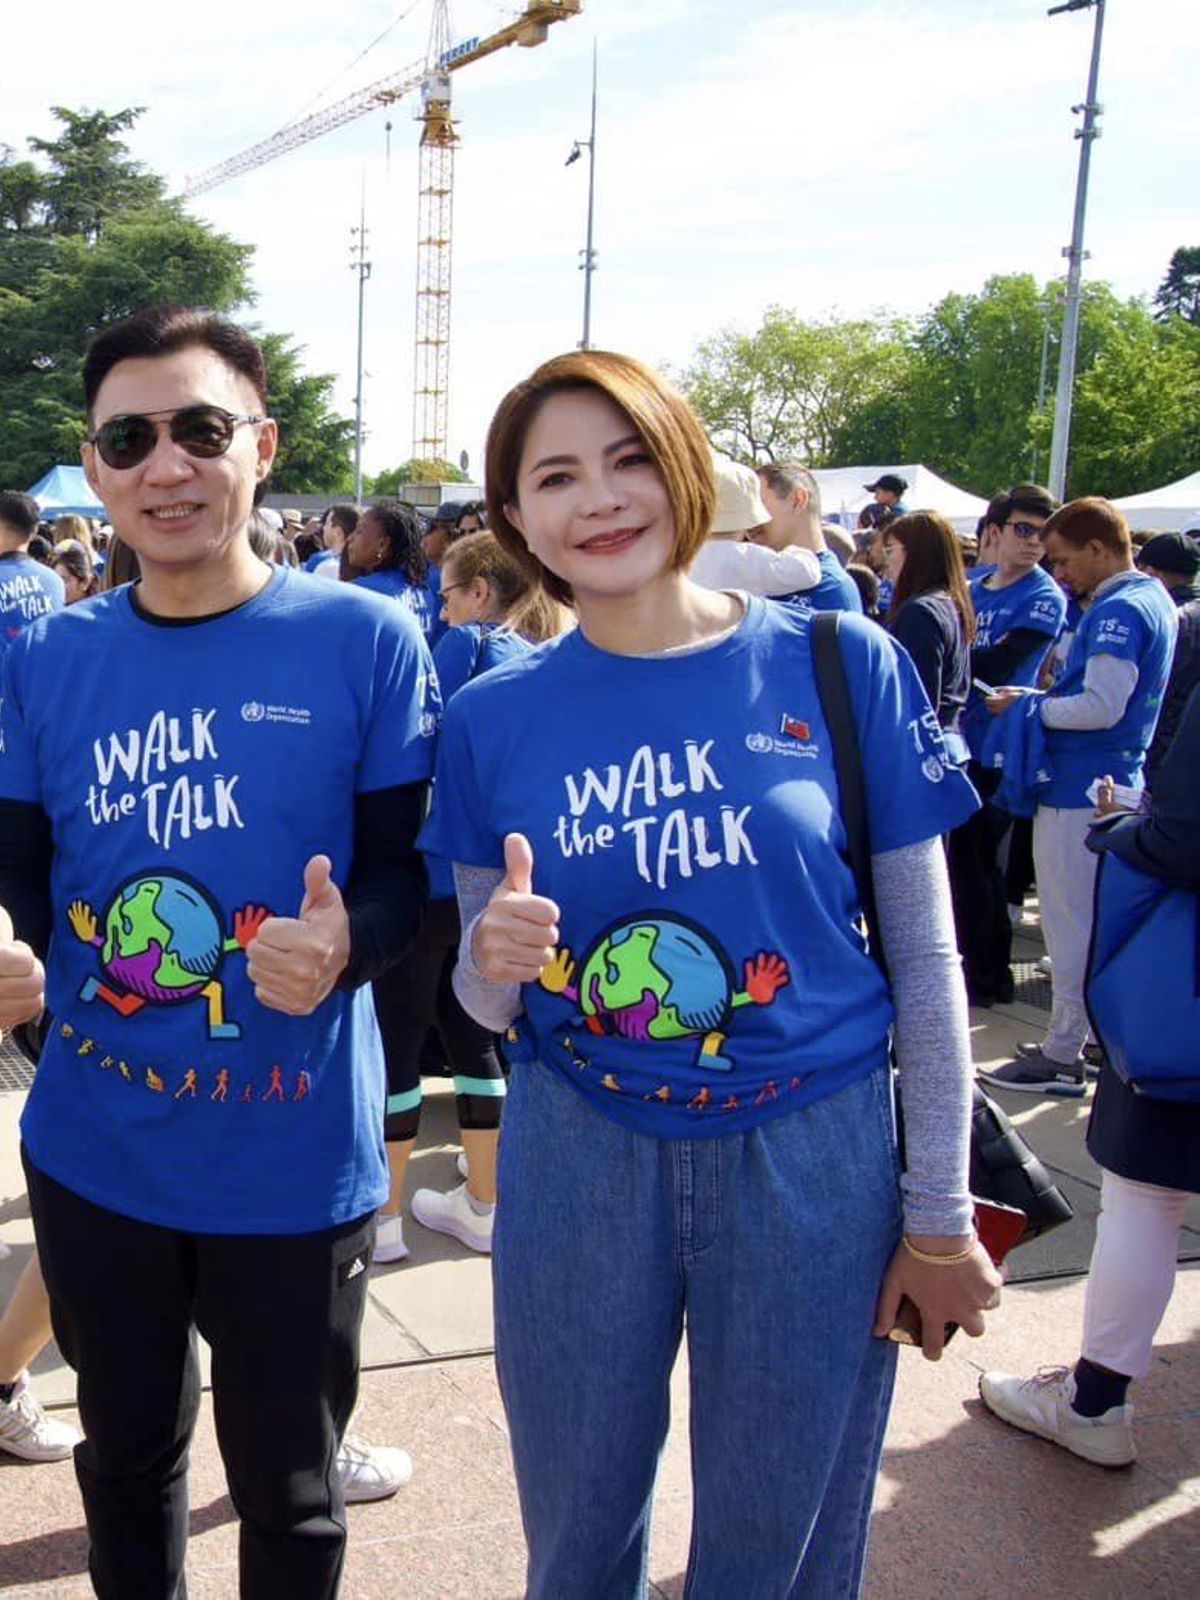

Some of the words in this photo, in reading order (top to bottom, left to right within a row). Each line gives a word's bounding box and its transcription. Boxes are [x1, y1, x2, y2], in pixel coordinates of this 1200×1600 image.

[17, 595, 54, 621] TALK
[94, 708, 218, 785] WALK
[564, 739, 723, 817] WALK
[85, 785, 136, 826] the
[141, 774, 244, 850] TALK
[553, 816, 615, 858] the
[622, 804, 759, 890] TALK
